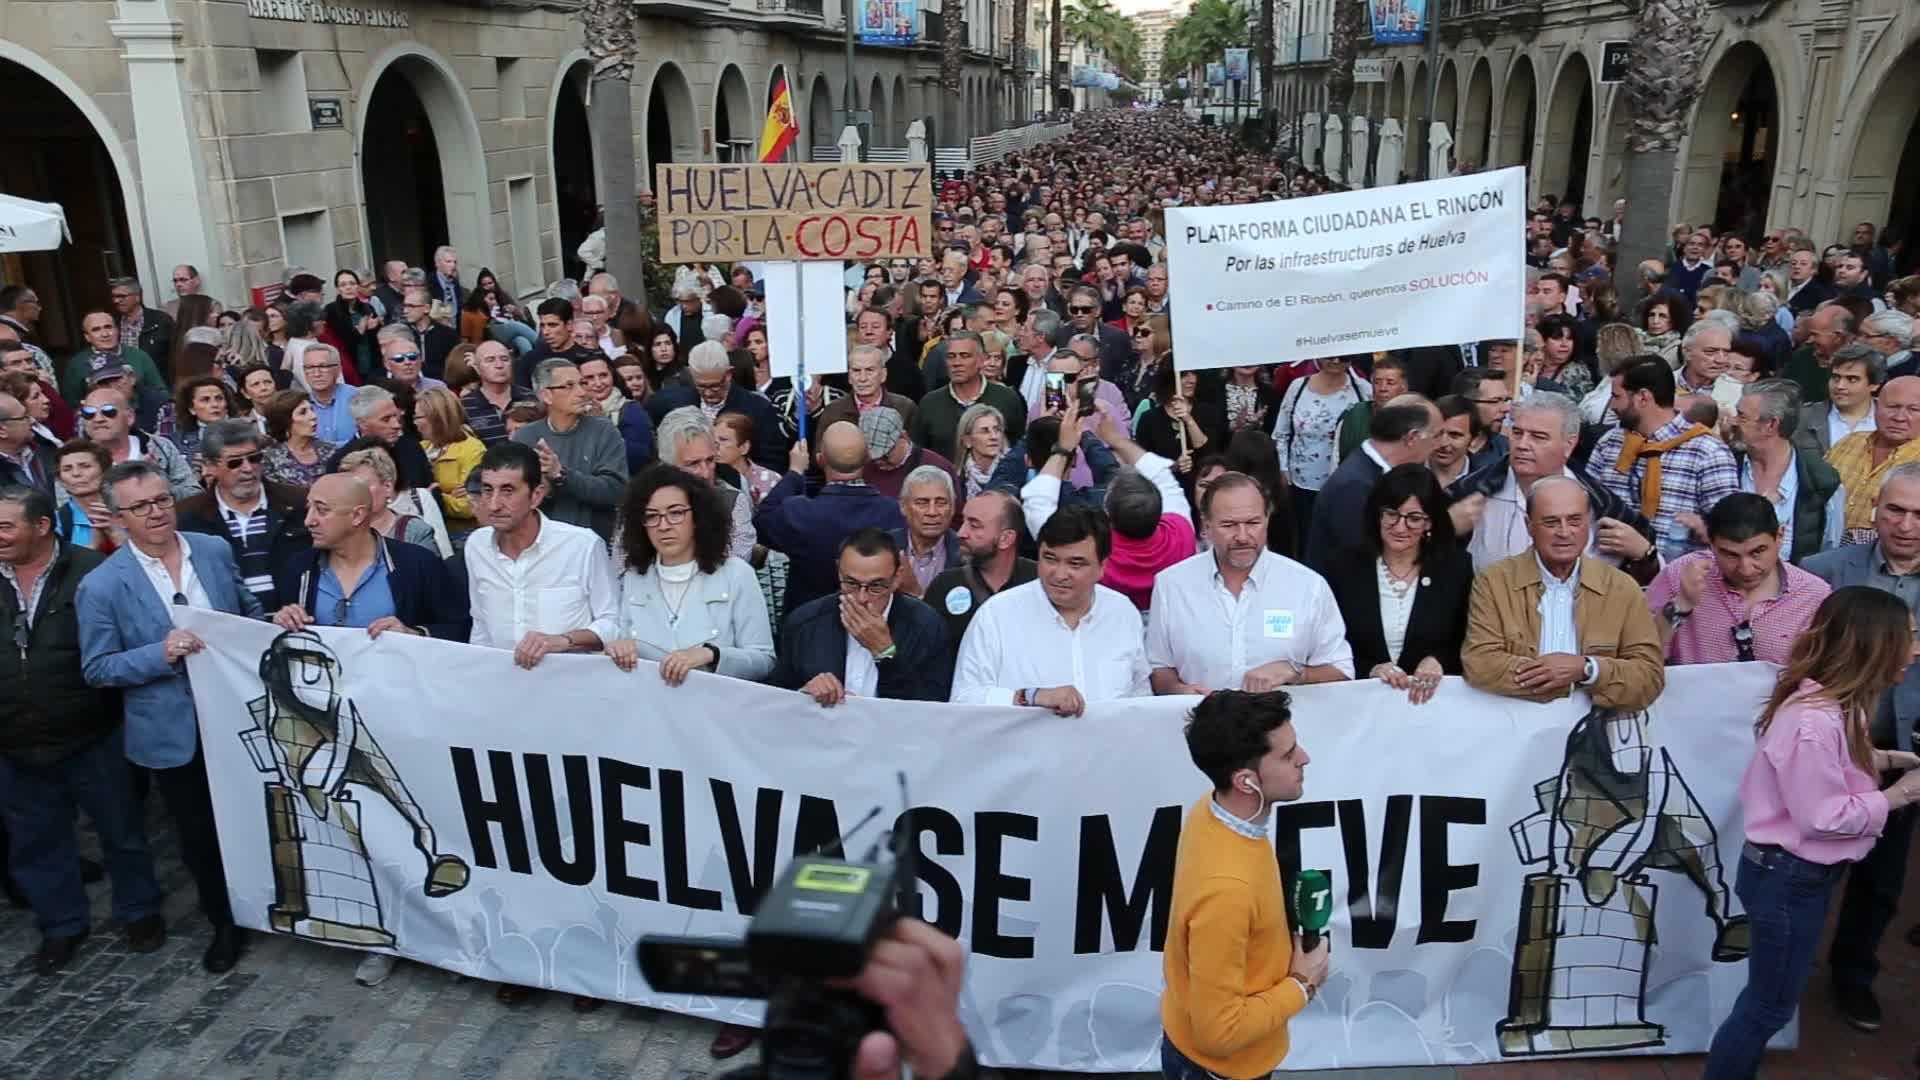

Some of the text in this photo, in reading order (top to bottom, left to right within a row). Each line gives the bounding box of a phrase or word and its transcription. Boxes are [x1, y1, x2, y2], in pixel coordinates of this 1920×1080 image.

[1186, 187, 1504, 244] PLATAFORMA CIUDADANA EL RINCÓN
[1225, 230, 1467, 272] Por las infraestructuras de Huelva
[1216, 299, 1263, 311] Camino
[1265, 297, 1281, 308] de
[1285, 295, 1297, 306] El
[1350, 283, 1408, 300] queremos
[1409, 270, 1489, 292] SOLUCIÓN
[1296, 326, 1399, 347] #Huelvasemueve
[894, 806, 1039, 959] SE
[1074, 794, 1487, 955] MEVE
